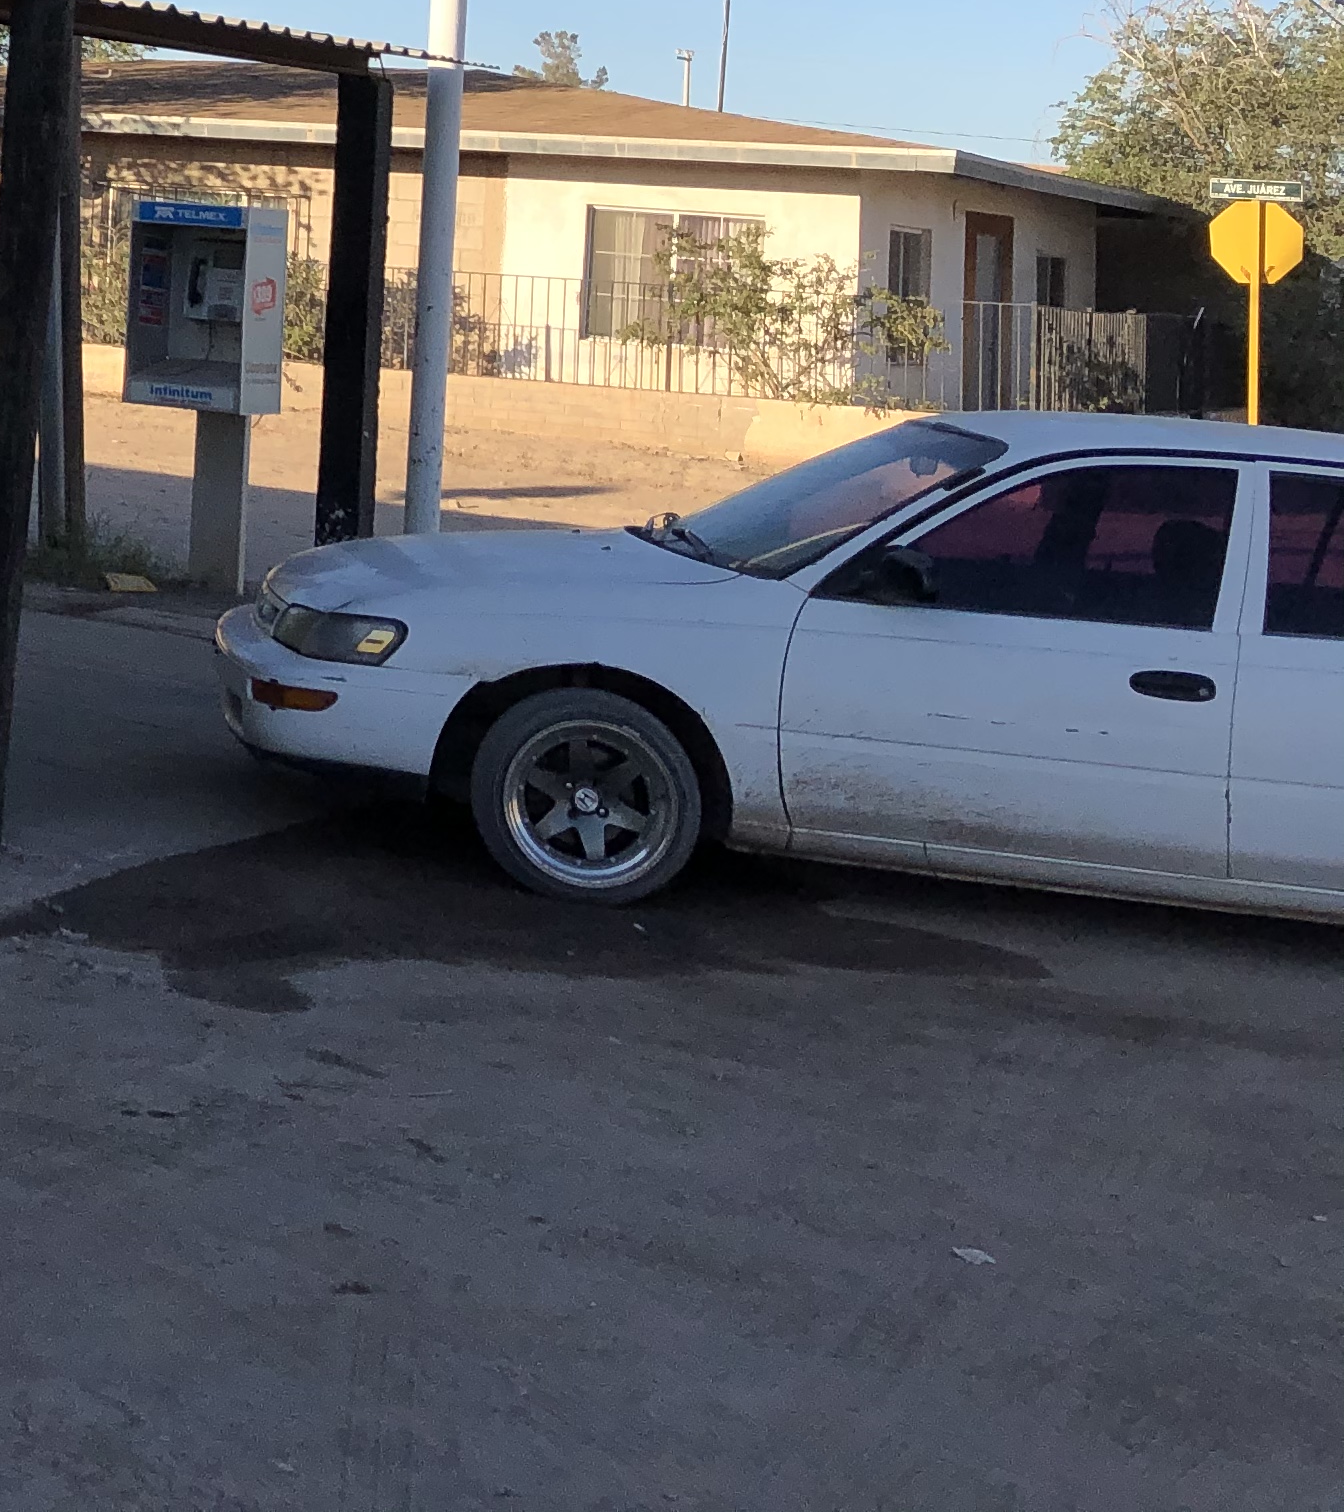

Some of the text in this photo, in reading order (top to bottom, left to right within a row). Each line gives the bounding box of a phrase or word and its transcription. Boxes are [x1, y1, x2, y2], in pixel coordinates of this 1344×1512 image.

[1223, 182, 1286, 196] AVE. JUÁREZ
[177, 209, 226, 221] TELMEX
